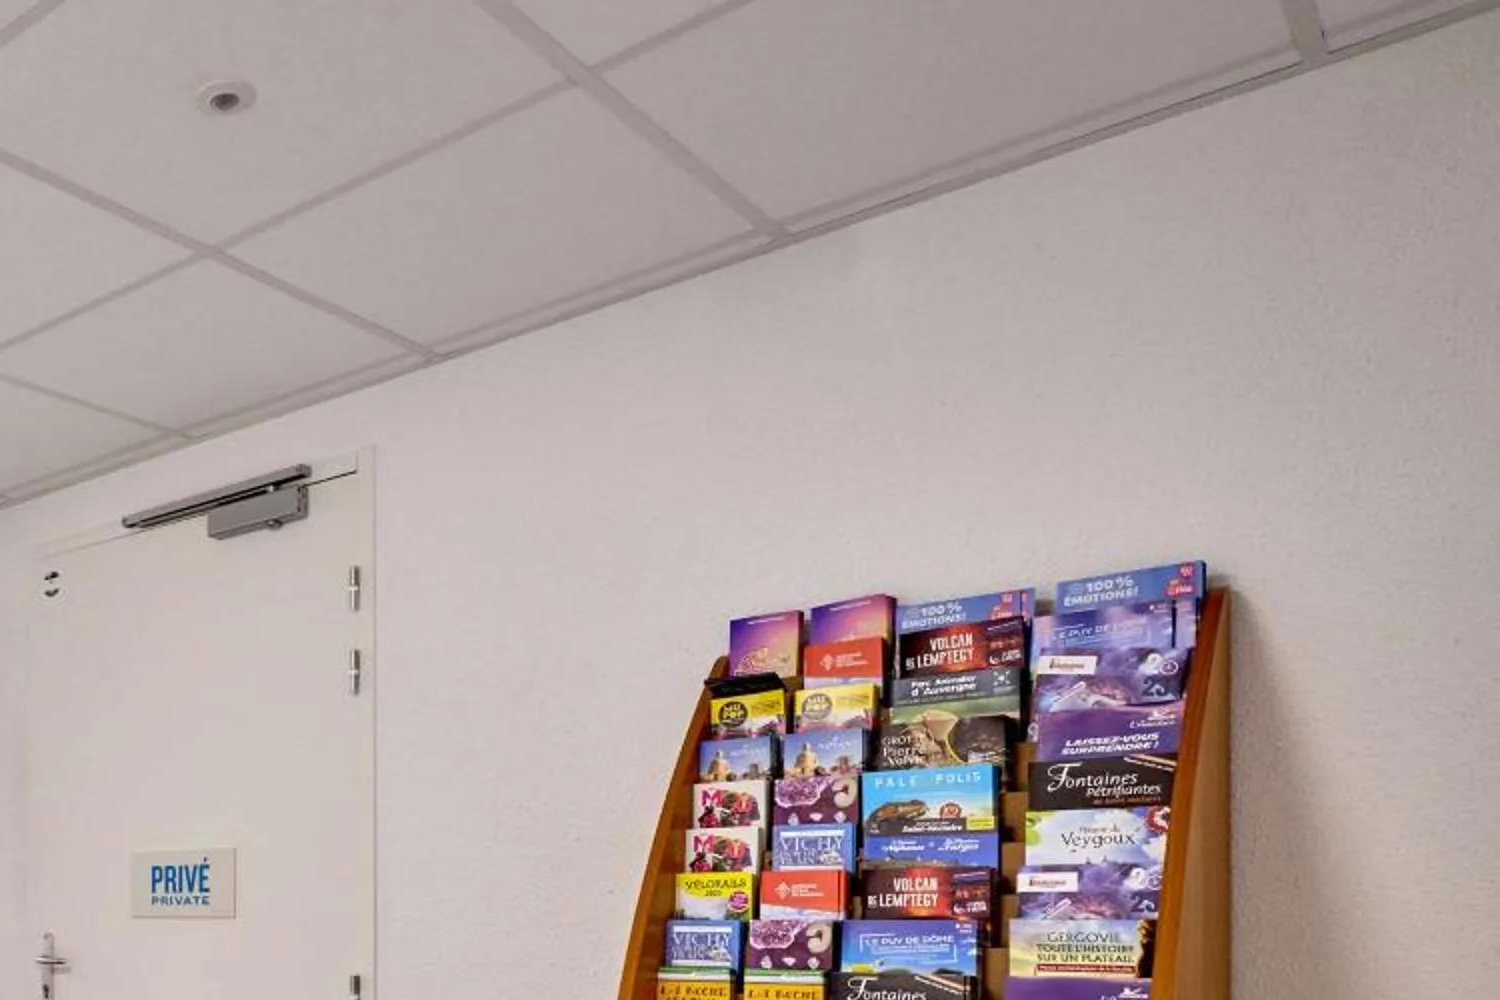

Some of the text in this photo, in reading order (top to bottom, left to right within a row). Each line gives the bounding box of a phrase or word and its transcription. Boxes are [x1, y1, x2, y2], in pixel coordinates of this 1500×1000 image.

[929, 632, 974, 652] VOLCAN
[1047, 761, 1139, 792] Fontaines
[779, 836, 845, 851] VICHY
[1061, 831, 1136, 848] Veygoux
[151, 857, 210, 893] PRIVÉ
[893, 877, 938, 892] VOLCAN
[151, 895, 210, 905] PRIVATE
[672, 932, 731, 946] VICHY
[1060, 953, 1079, 962] UN
